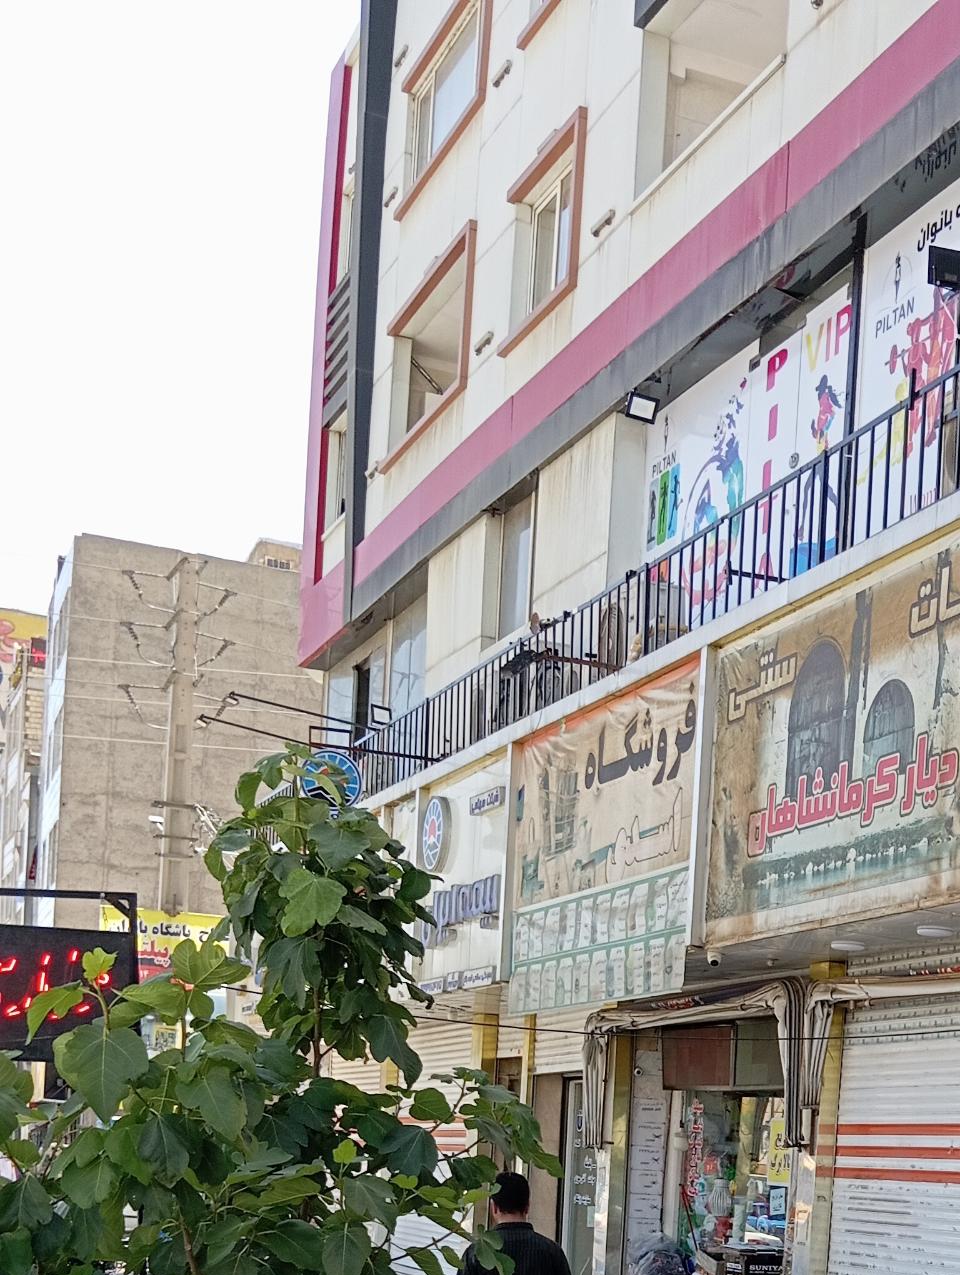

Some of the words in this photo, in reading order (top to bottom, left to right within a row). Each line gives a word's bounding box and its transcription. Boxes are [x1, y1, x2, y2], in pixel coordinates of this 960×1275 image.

[917, 209, 953, 252] بانوان
[806, 304, 853, 372] VIP
[875, 297, 915, 338] PILTAN
[652, 450, 677, 478] PILTAN
[727, 648, 798, 724] سنتی
[584, 681, 698, 790] فروشگاه
[901, 732, 959, 814] دیار
[747, 753, 901, 857] کرمانشاهان
[138, 940, 171, 967] پیلت
[152, 922, 191, 938] باشگاه
